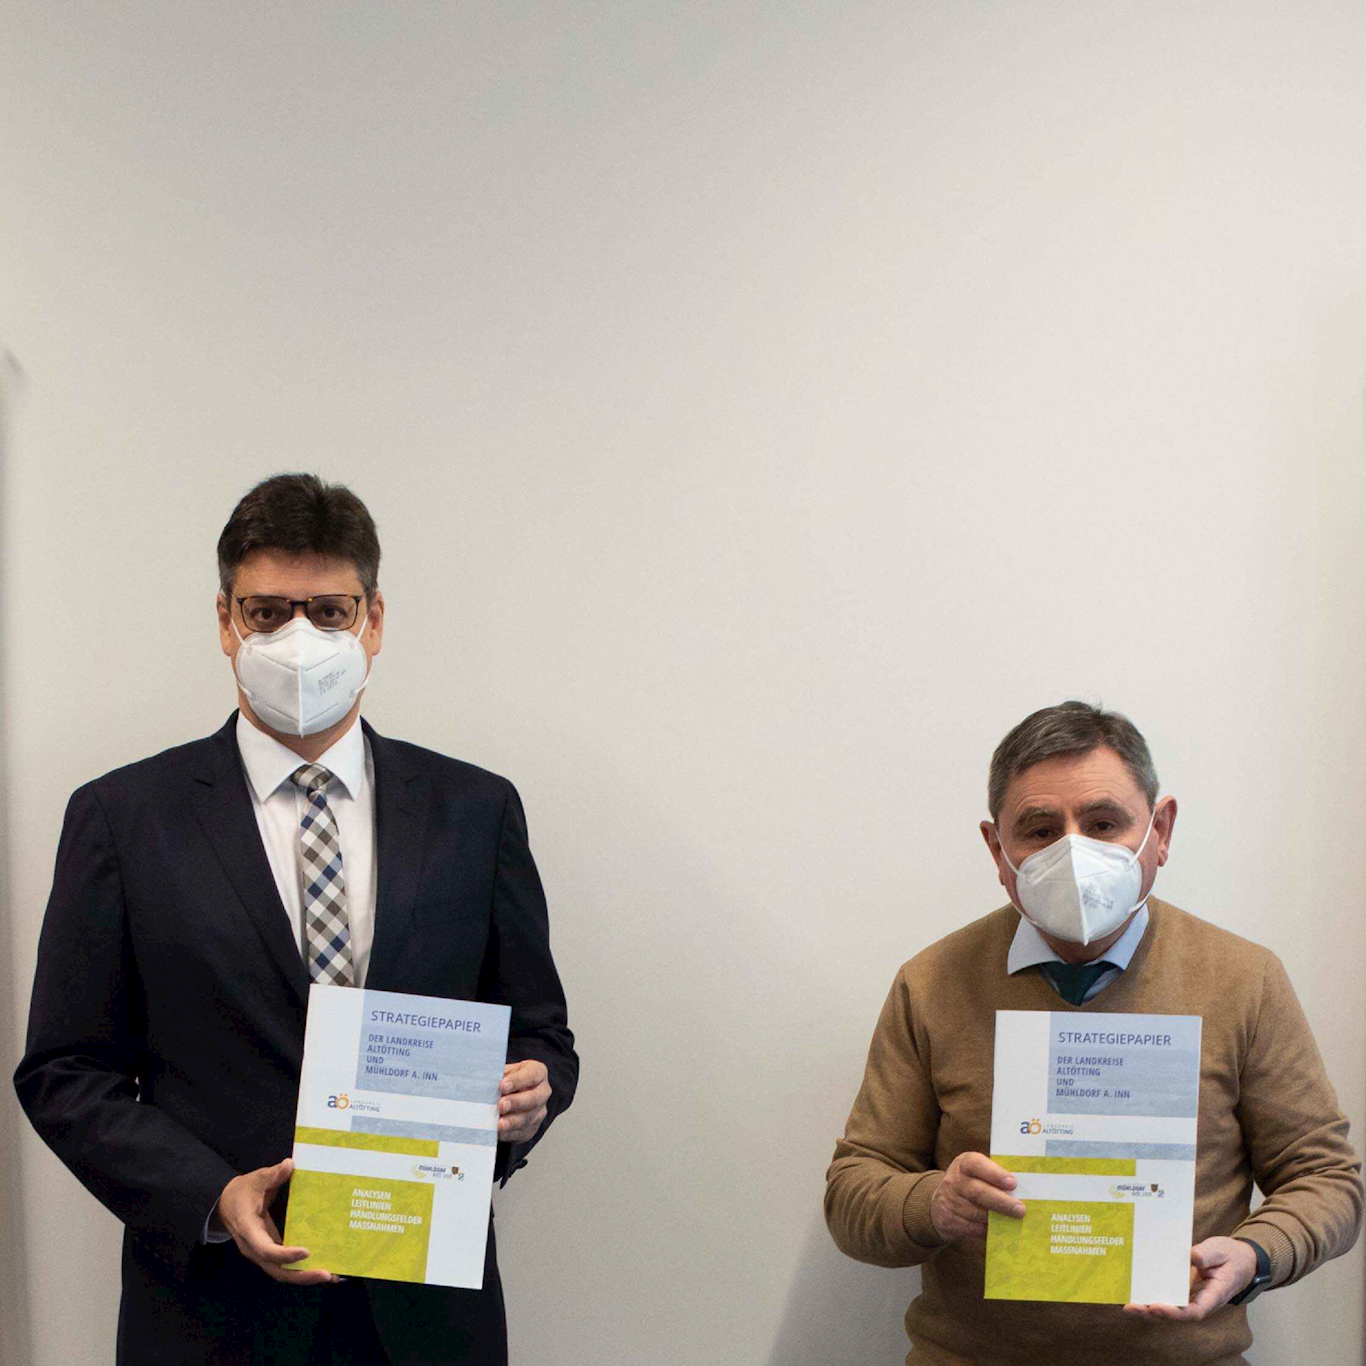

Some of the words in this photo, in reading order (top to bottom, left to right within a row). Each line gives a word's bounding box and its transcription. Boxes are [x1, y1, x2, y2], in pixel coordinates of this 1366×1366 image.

[371, 1010, 481, 1033] STRATEGIEPAPIER
[368, 1033, 384, 1043] DER
[386, 1036, 434, 1049] LANDKREISE
[1058, 1031, 1172, 1046] STRATEGIEPAPIER
[367, 1044, 410, 1057] ALTÖTTING
[366, 1055, 384, 1065] UND
[1057, 1056, 1073, 1065] DER
[1075, 1056, 1124, 1066] LANDKREISE
[365, 1065, 410, 1078] MÜHLDORF
[411, 1071, 419, 1079] A.
[422, 1072, 438, 1081] INN
[1056, 1066, 1101, 1076] ALTÖTTING
[1056, 1078, 1075, 1086] UND
[1056, 1088, 1100, 1098] MÜHLDORF
[1103, 1090, 1112, 1098] A.
[1114, 1090, 1131, 1099] INN
[352, 1188, 391, 1200] ANALYSEN
[351, 1199, 391, 1211] LEITLINIEN
[350, 1209, 423, 1225] HANDLUNGSFELDER
[1051, 1213, 1091, 1223] ANALYSEN
[349, 1220, 405, 1234] MASSNAHMEN
[1051, 1224, 1091, 1234] LEITLINIEN
[1051, 1235, 1124, 1246] HANDLUNGSFELDER
[1050, 1246, 1106, 1256] MASSNAHMEN
